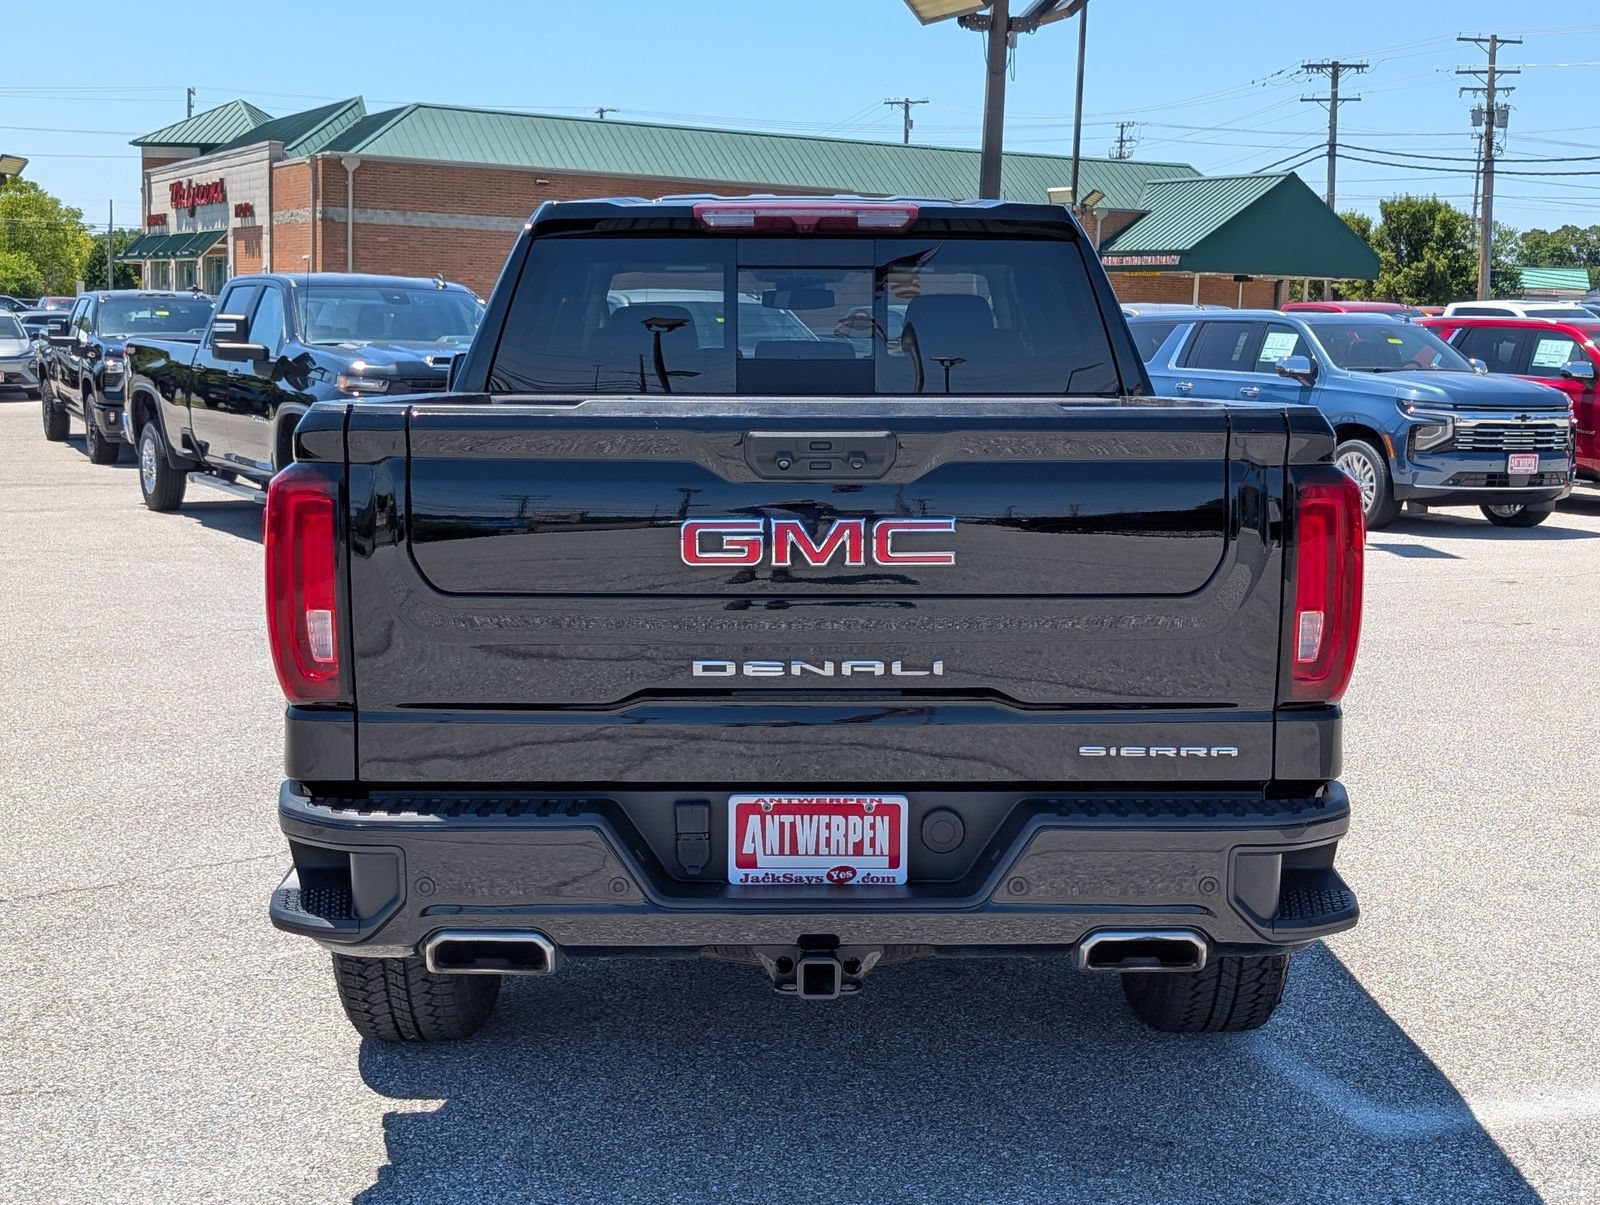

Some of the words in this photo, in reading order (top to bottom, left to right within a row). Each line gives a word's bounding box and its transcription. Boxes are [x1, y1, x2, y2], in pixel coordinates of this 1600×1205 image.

[680, 517, 957, 566] GMC
[692, 660, 944, 677] DENALI
[1078, 745, 1239, 757] SIERRA
[754, 797, 883, 805] ANTWERPEN
[742, 815, 890, 860] ANTWERPEN
